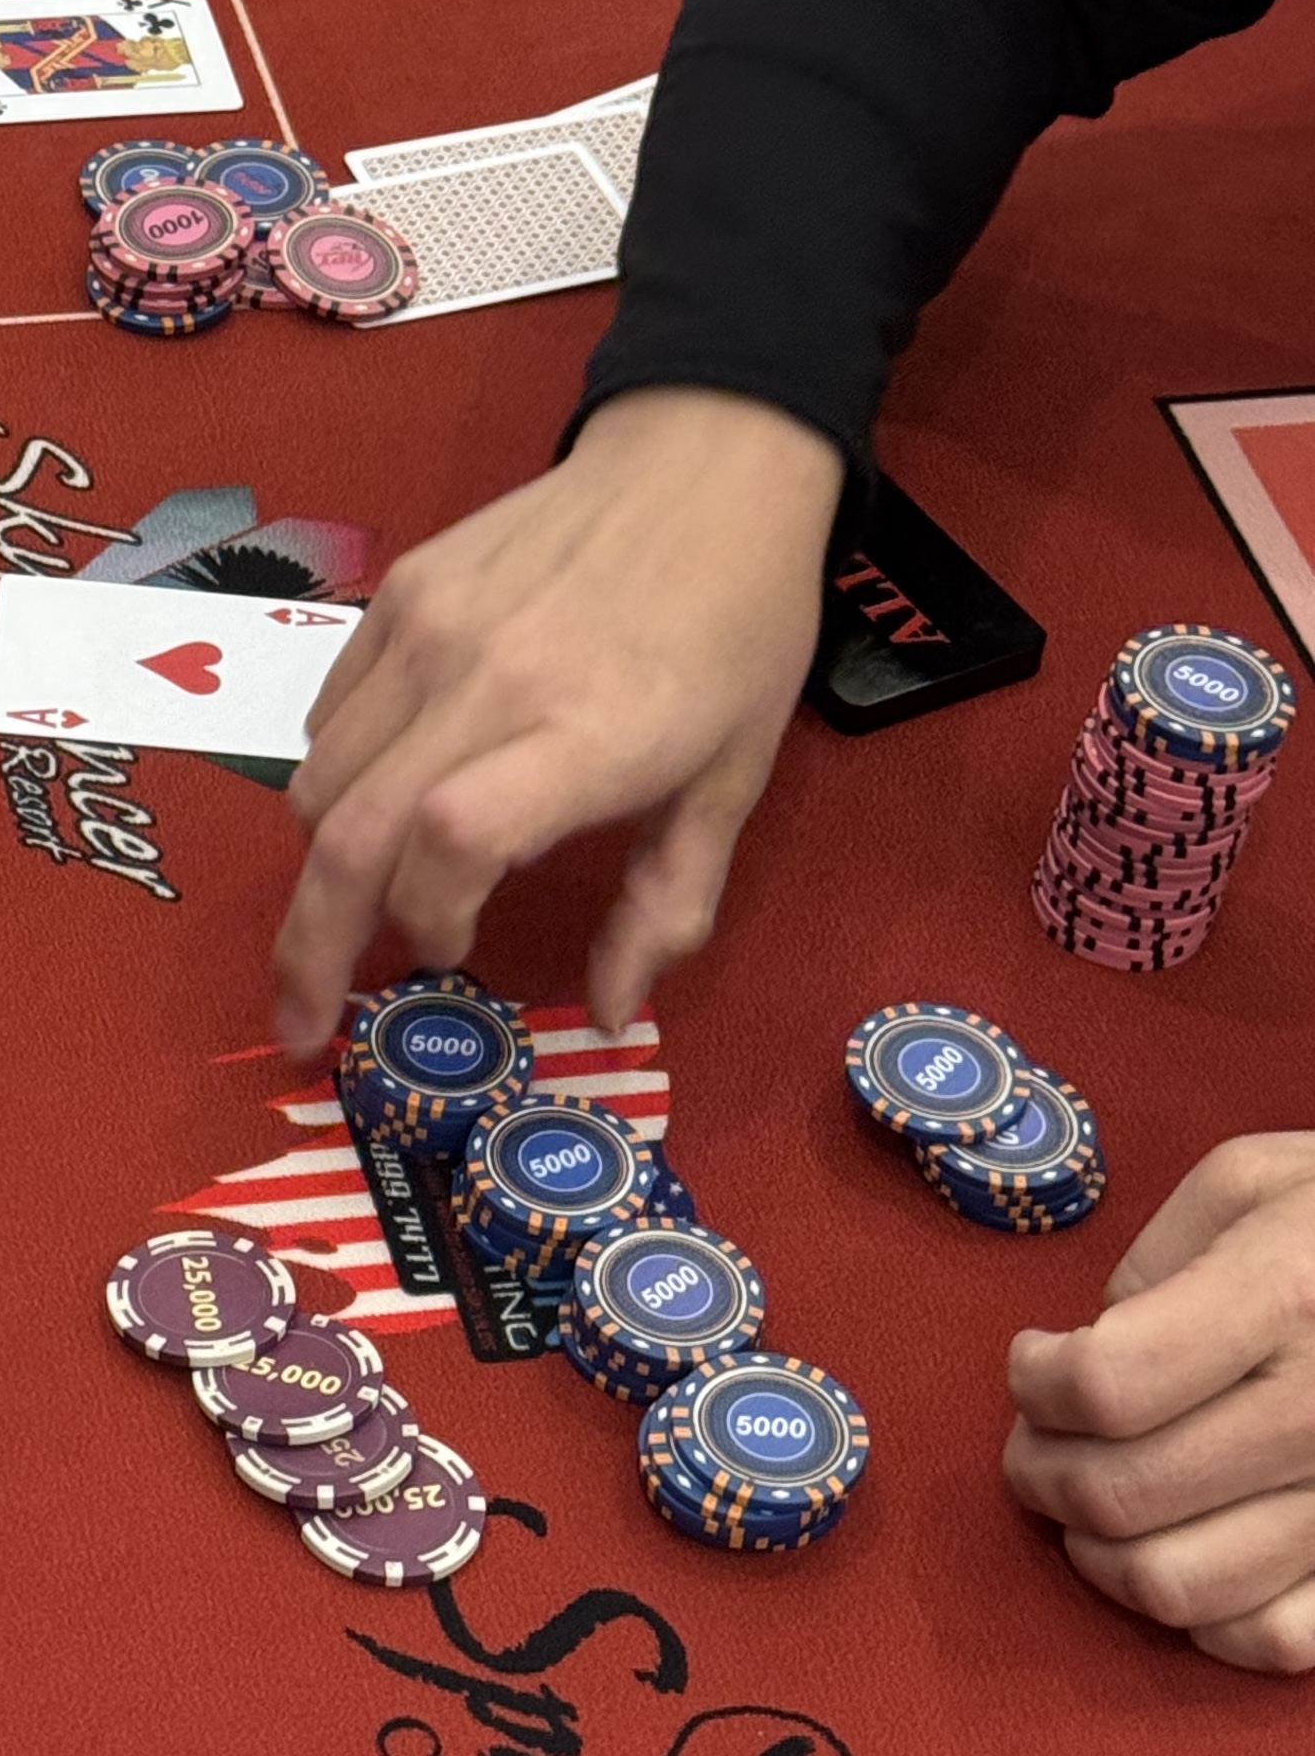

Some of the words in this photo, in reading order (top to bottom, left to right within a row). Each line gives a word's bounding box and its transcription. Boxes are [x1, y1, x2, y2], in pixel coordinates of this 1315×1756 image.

[148, 208, 204, 240] 1000
[295, 608, 348, 628] A
[1172, 663, 1240, 703] 5000
[5, 708, 59, 729] A
[0, 738, 83, 865] Resort
[409, 1032, 478, 1059] 5000
[914, 1045, 964, 1092] 5000
[529, 1143, 592, 1179] 5000
[181, 1255, 222, 1333] 25,000
[641, 1265, 700, 1311] 5000
[735, 1413, 807, 1440] 5000
